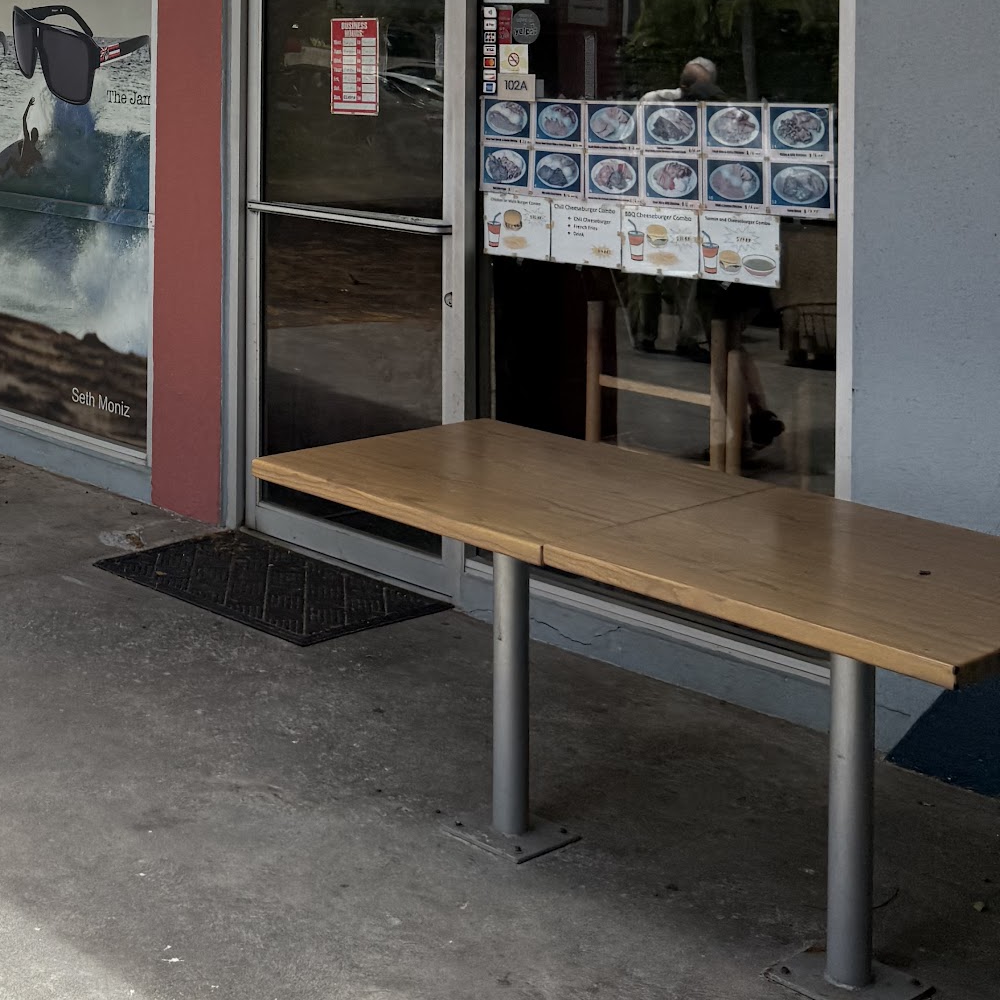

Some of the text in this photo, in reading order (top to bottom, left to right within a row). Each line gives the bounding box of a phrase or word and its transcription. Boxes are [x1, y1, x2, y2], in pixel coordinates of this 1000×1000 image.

[341, 22, 368, 30] BUSINESS
[504, 80, 528, 91] 102A
[106, 89, 127, 104] The
[565, 205, 597, 213] Cheeseburger
[636, 212, 672, 221] Cheeseburger
[583, 217, 611, 225] Cheeseburger
[728, 217, 755, 225] Cheeseburger
[71, 387, 131, 419] Seth Moniz
